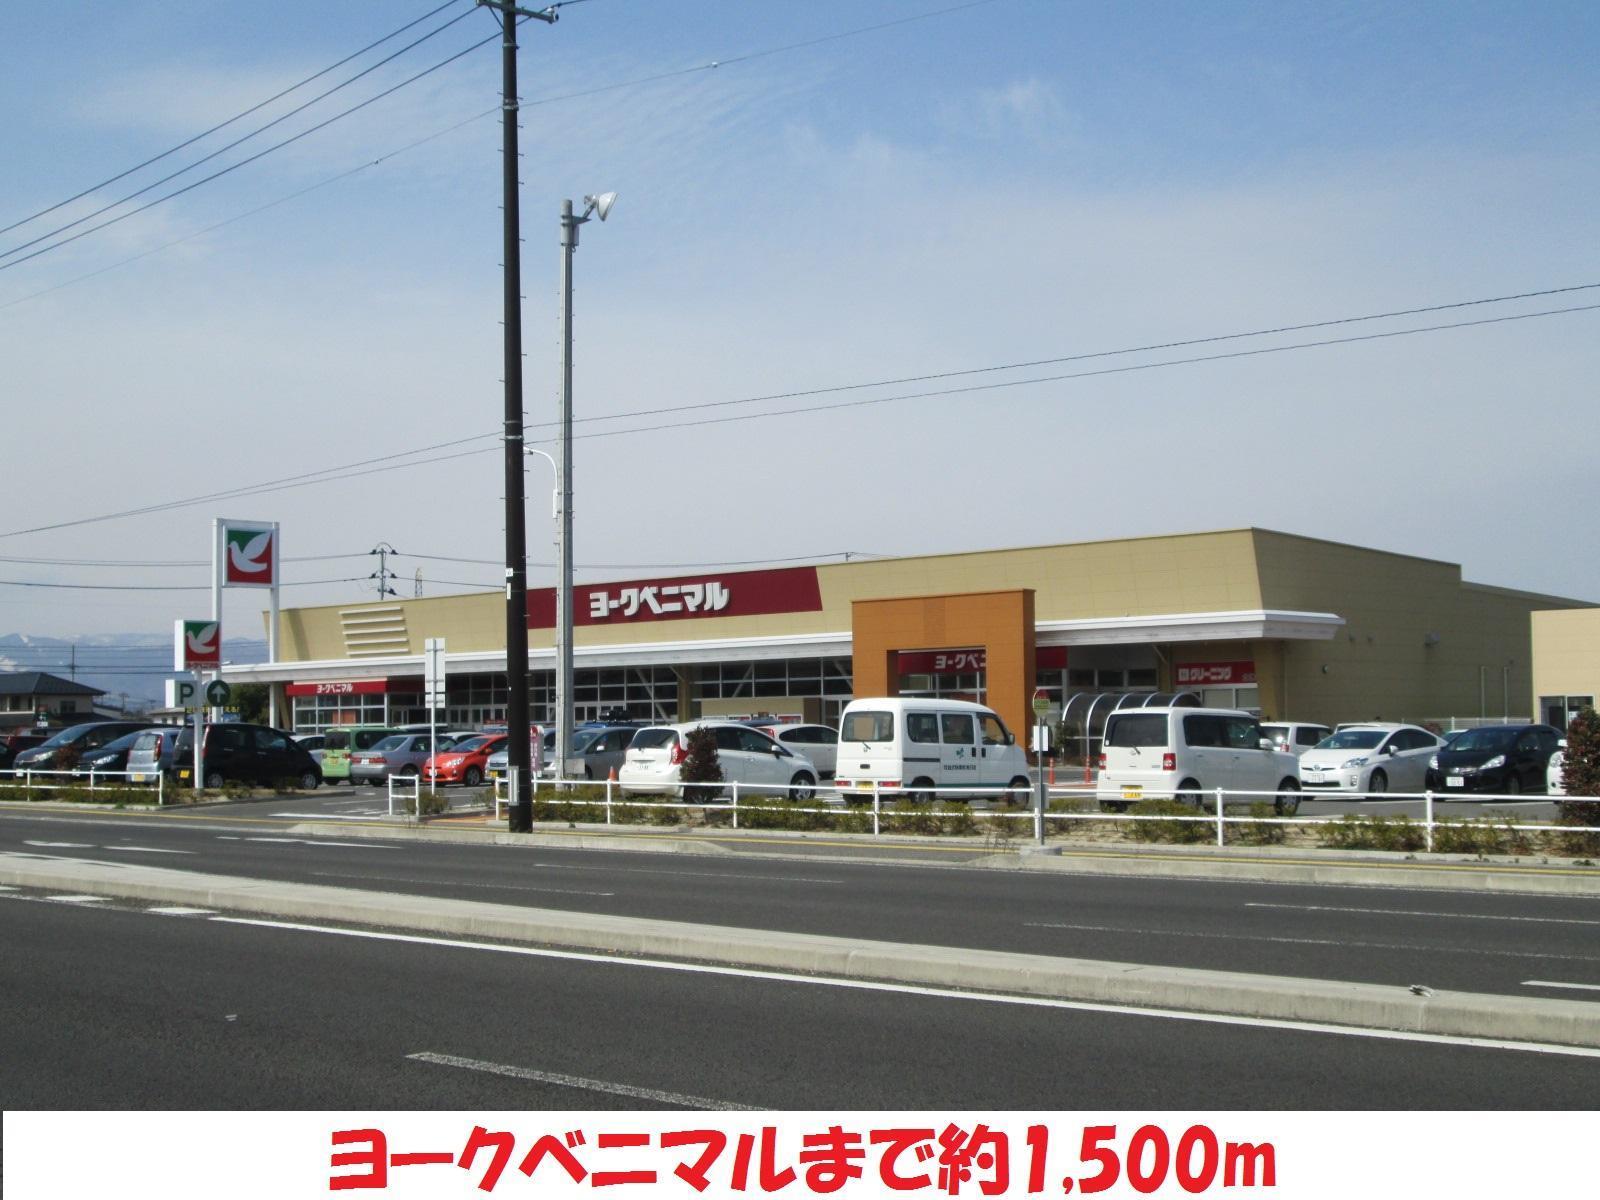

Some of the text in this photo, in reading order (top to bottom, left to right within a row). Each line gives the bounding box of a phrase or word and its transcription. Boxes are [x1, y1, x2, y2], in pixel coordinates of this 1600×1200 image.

[589, 582, 729, 618] ヨークベニマル
[180, 683, 194, 704] P
[316, 683, 353, 694] ヨークベニマル
